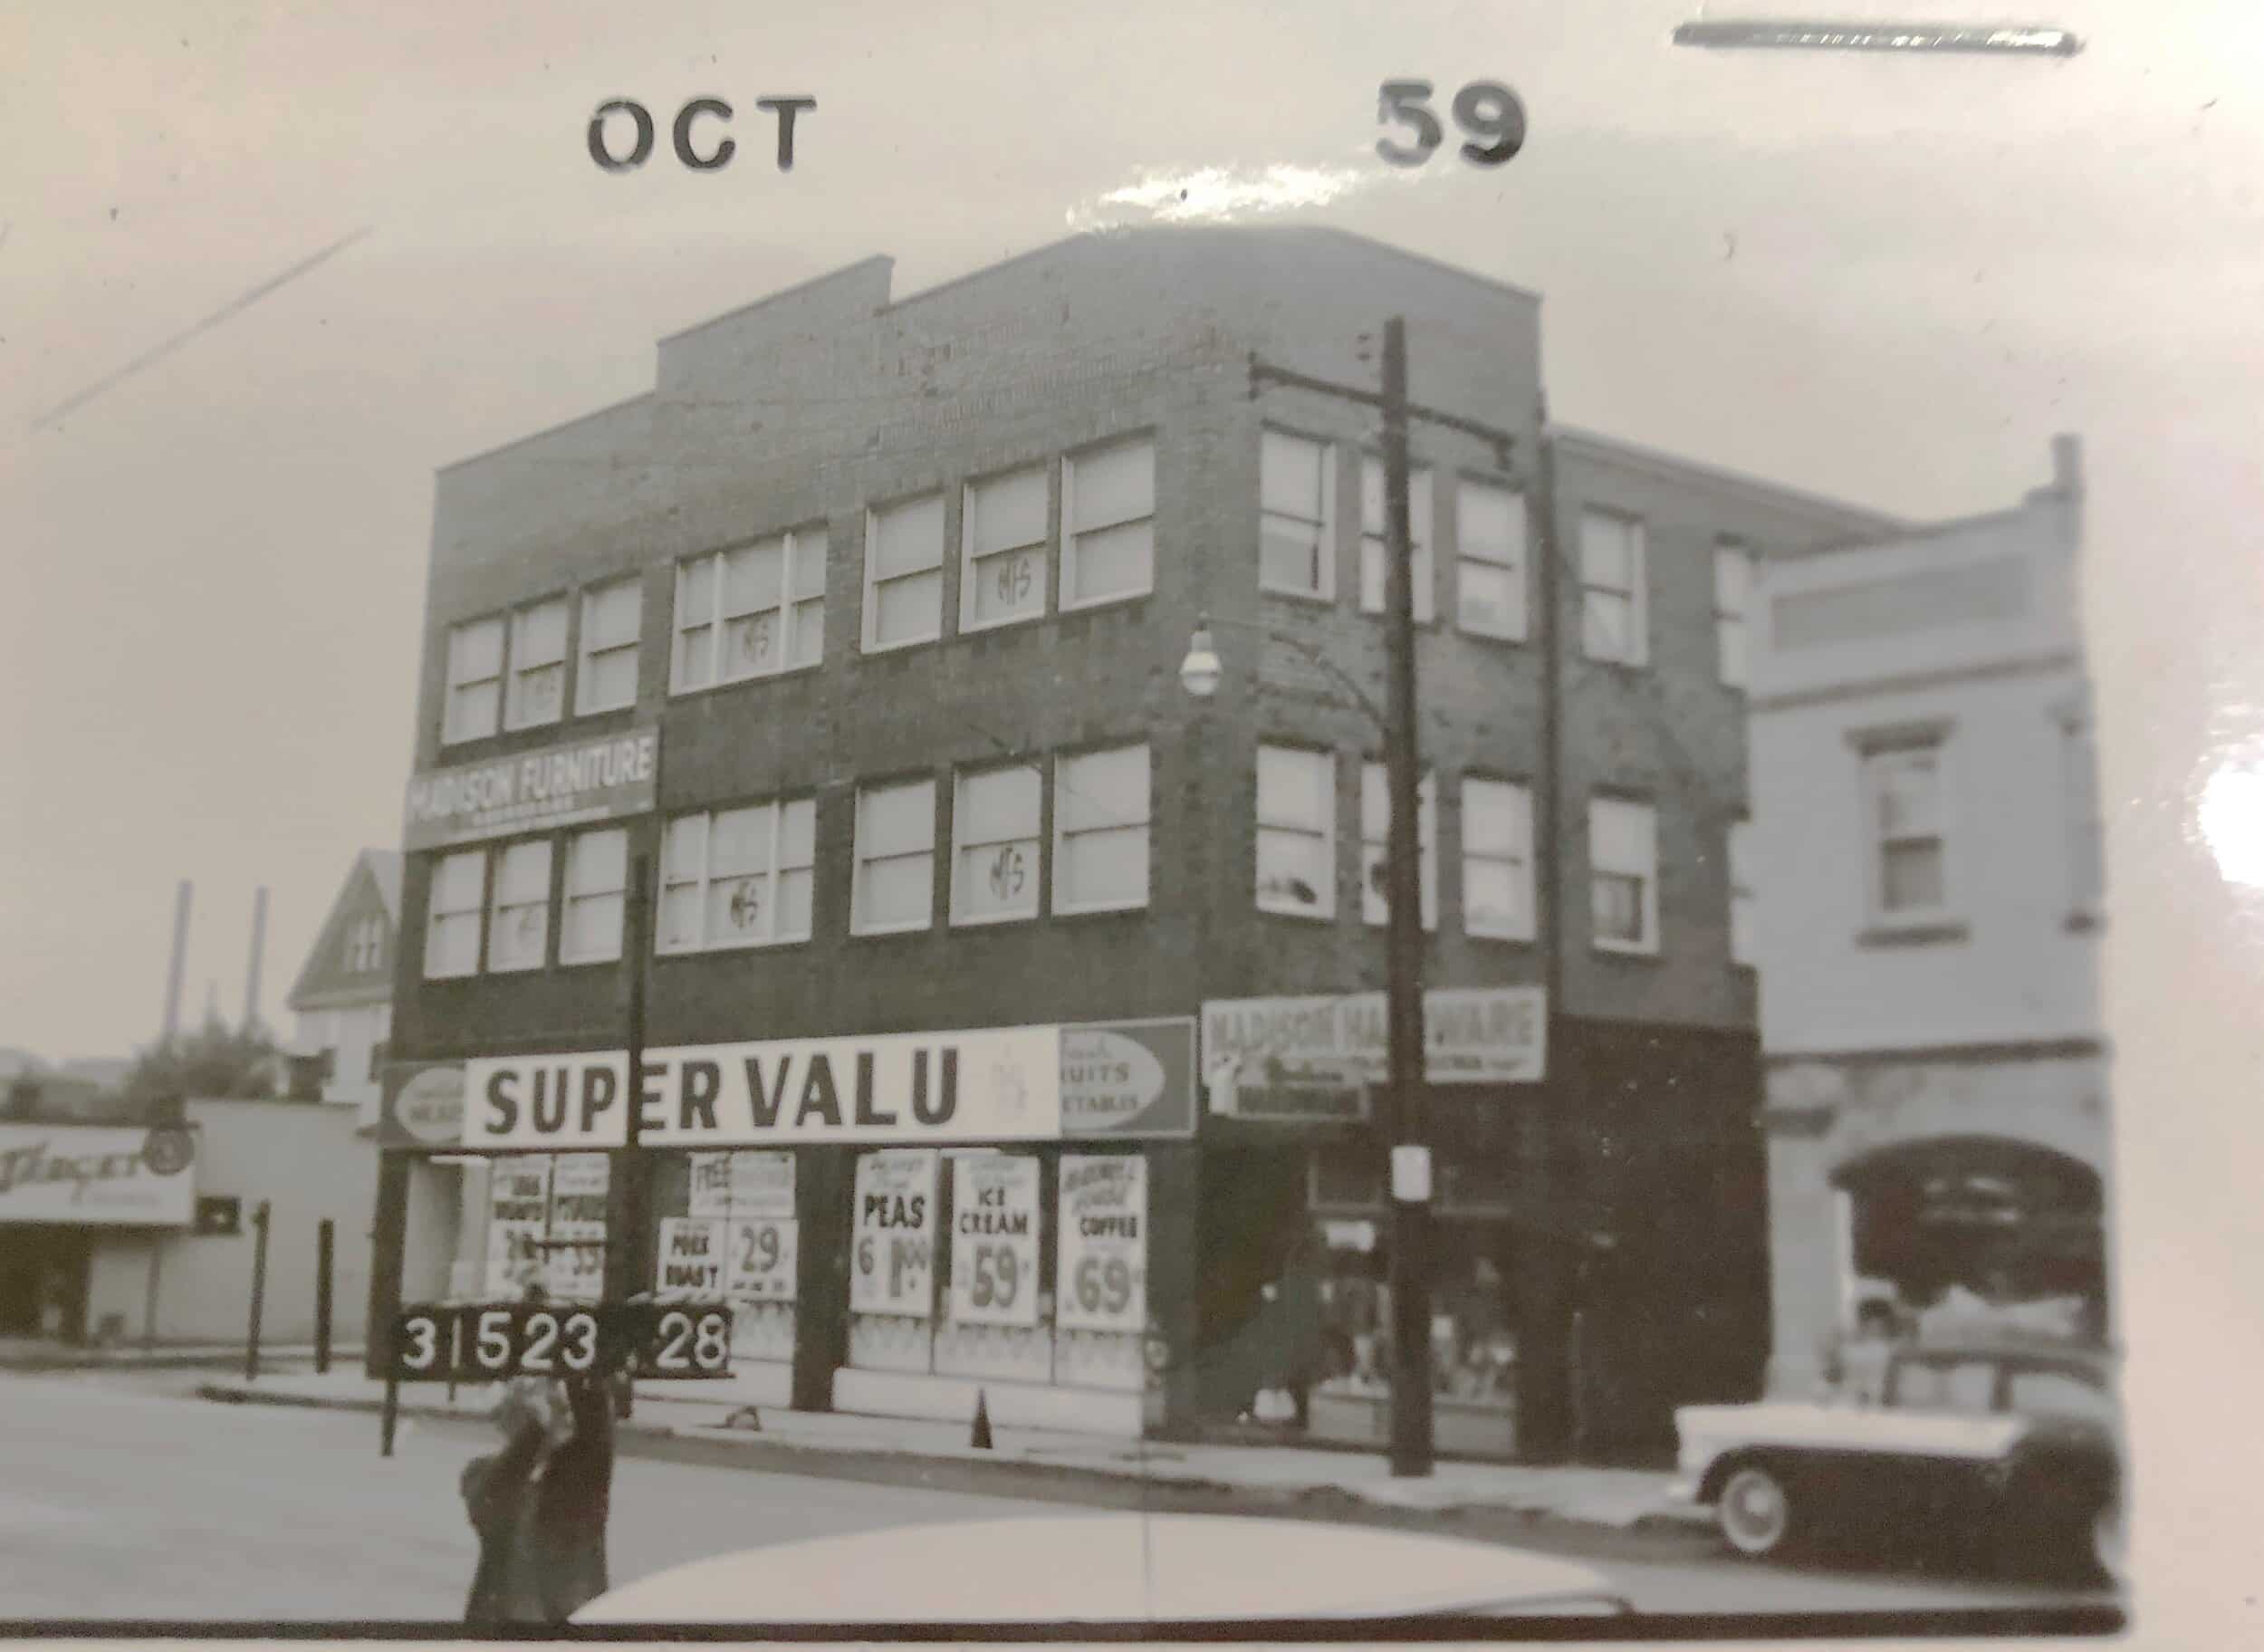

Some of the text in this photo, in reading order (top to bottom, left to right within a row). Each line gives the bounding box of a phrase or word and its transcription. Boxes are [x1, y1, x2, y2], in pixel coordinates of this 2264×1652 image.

[523, 735, 654, 802] FURNITURE
[484, 1048, 959, 1135] SUPER VALU
[864, 1194, 926, 1229] PEAS
[978, 1186, 1006, 1207] ICE
[960, 1211, 1029, 1235] CREAM
[1079, 1216, 1138, 1239] COFFEE
[741, 1225, 780, 1273] 29
[858, 1234, 875, 1276] 6
[972, 1245, 1019, 1308] 59
[1075, 1255, 1132, 1315] 69
[402, 1311, 729, 1369] 31523 28
